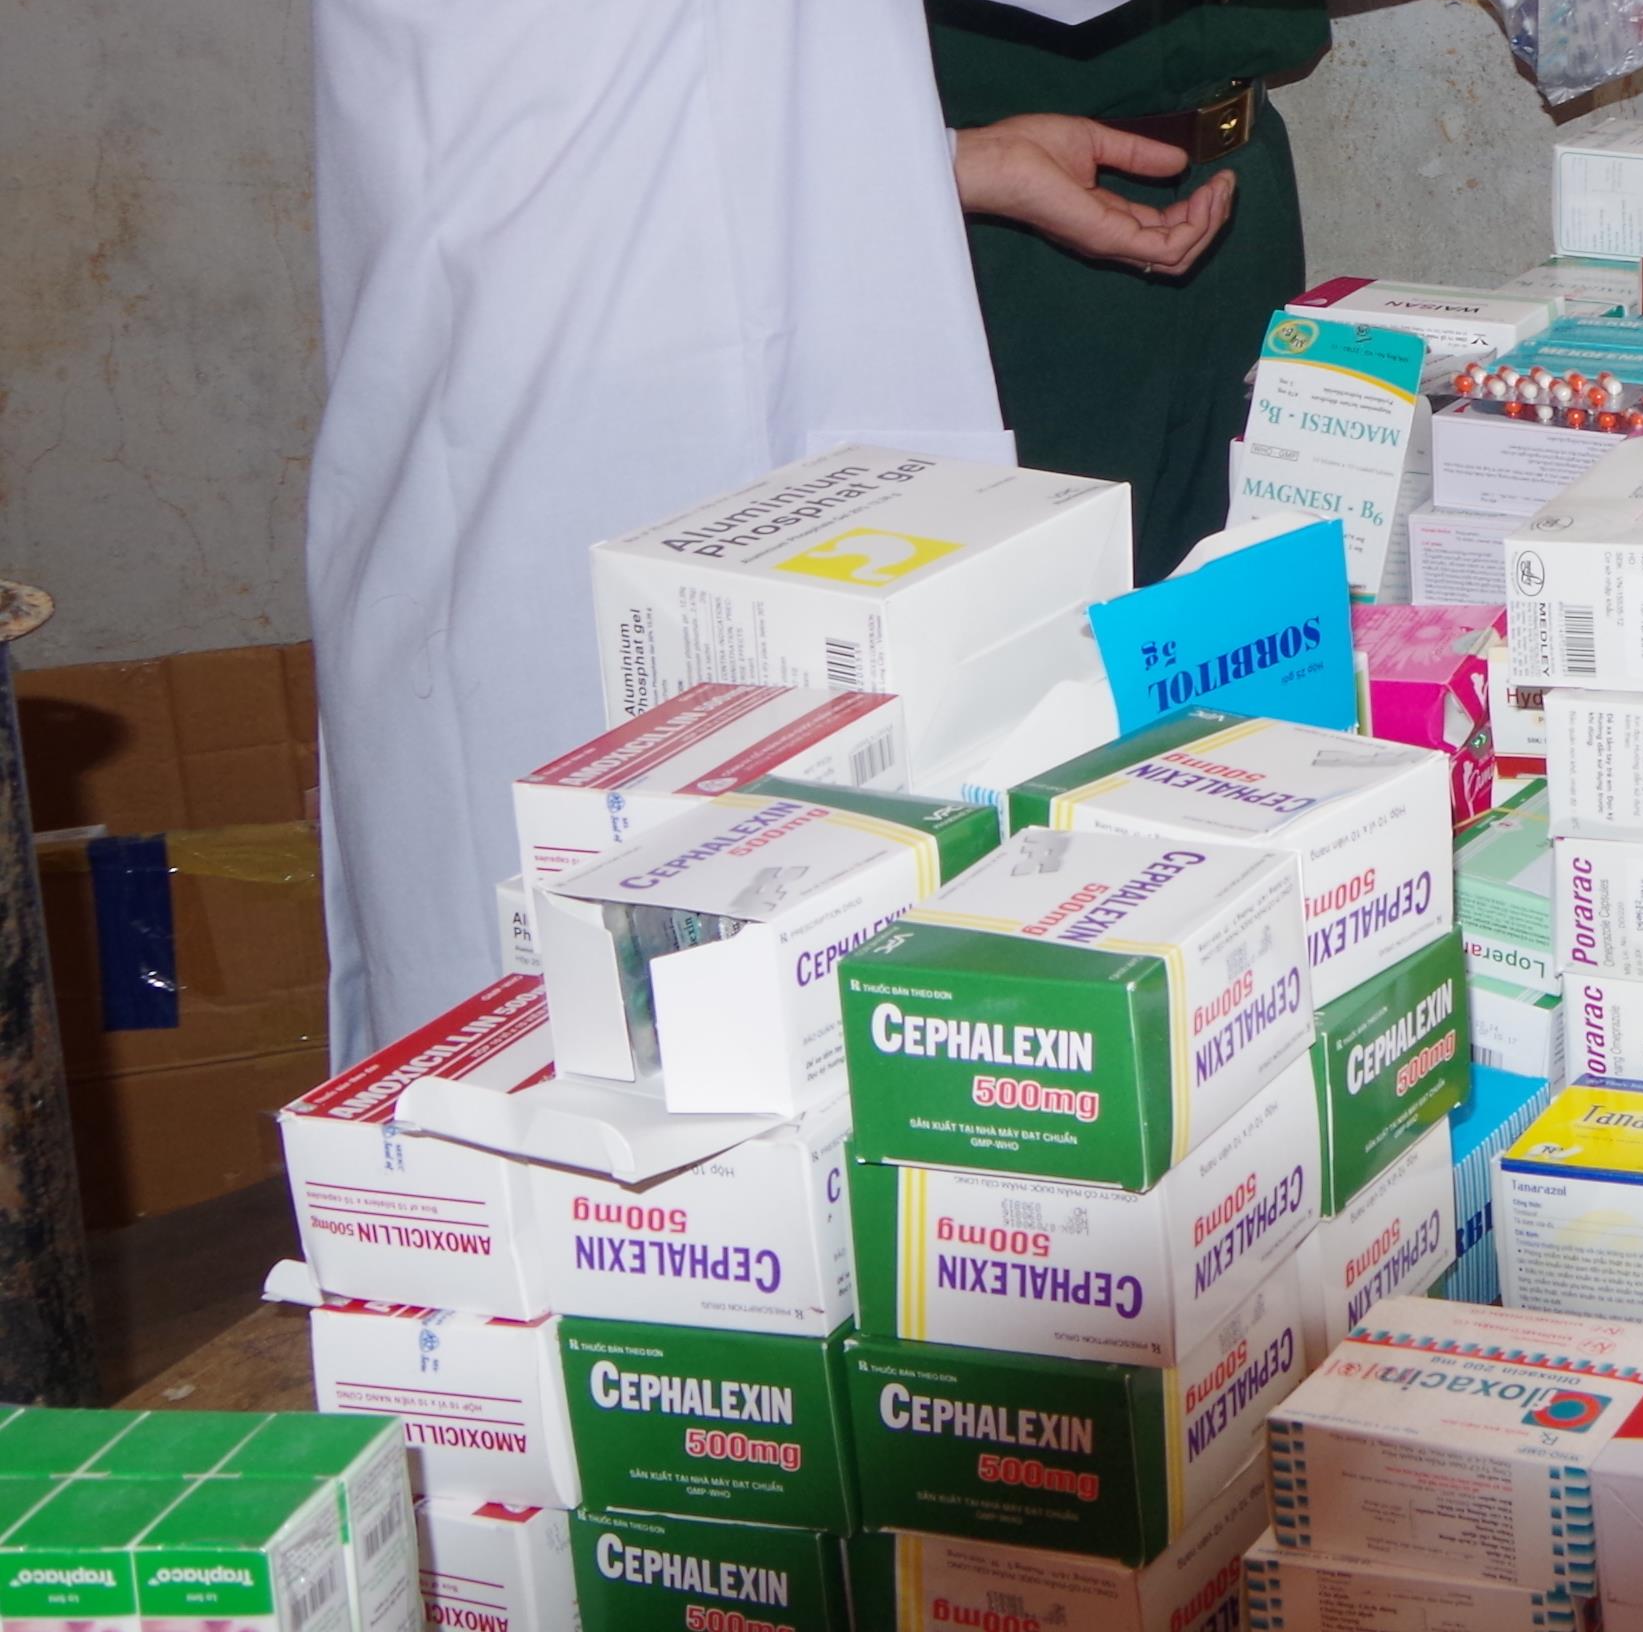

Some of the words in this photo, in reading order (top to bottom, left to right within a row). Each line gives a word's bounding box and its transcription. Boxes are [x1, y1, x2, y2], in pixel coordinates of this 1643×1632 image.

[1385, 300, 1480, 313] WAISAN
[1259, 399, 1281, 424] B6
[1302, 412, 1401, 446] MAGNESI
[661, 464, 870, 553] Aluminium
[695, 477, 880, 560] Phosphat
[878, 458, 936, 484] gel
[1242, 477, 1342, 513] MAGNESI
[1361, 500, 1383, 526] B6
[631, 608, 646, 634] gel
[1539, 602, 1550, 677] MEDLEY
[619, 623, 636, 717] Aluminium
[1148, 617, 1321, 714] SORBITOL
[558, 708, 702, 787] AMOXICILLIN
[1160, 752, 1266, 784] 500mg
[1126, 763, 1317, 815] CEPHALEXIN
[619, 801, 803, 890] CEPHALEXIN
[727, 808, 831, 858] 500mg
[1022, 882, 1109, 936] 500mg
[1057, 850, 1207, 943] CEPHALEXIN
[1572, 857, 1598, 967] Porarac
[863, 982, 891, 994] THUỐC
[911, 987, 933, 998] THEO
[1192, 970, 1254, 1036] 500mg
[871, 1003, 1093, 1072] CEPHALEXIN
[1195, 966, 1301, 1089] CEPHALEXIN
[1347, 978, 1452, 1095] CEPHALEXIN
[1584, 985, 1606, 1077] orarac
[328, 1013, 495, 1120] AMOXICILLIN
[1396, 1029, 1456, 1097] 500mg
[973, 1076, 1099, 1122] 500mg
[976, 1124, 997, 1136] NHÀ
[998, 1127, 1019, 1138] MÁY
[970, 1137, 1019, 1151] GMP-WHO
[573, 1196, 688, 1234] 500mg
[1193, 1173, 1257, 1249] 500mg
[1512, 1180, 1567, 1196] Tanarazol
[311, 1216, 354, 1236] 500mg
[357, 1223, 491, 1256] AMOXICILLIN
[937, 1216, 1050, 1257] 500mg
[1194, 1164, 1304, 1299] CEPHALEXIN
[1345, 1218, 1401, 1289] 500mg
[575, 1234, 782, 1295] CEPHALEXIN
[938, 1254, 1143, 1319] CEPHALEXIN
[1347, 1208, 1442, 1331] CEPHALEXIN
[590, 1360, 792, 1425] CEPHALEXIN
[1185, 1339, 1247, 1414] 500mg
[1187, 1327, 1294, 1464] CEPHALEXIN
[405, 1423, 527, 1453] AMOXICILLI
[685, 1428, 801, 1472] 500mg
[880, 1383, 1094, 1455] CEPHALEXIN
[686, 1486, 731, 1499] GMP-WHO
[978, 1454, 1099, 1501] 500mg
[10, 1567, 117, 1587] Traphaco
[149, 1566, 255, 1587] Traphaco
[596, 1533, 788, 1608] CEPHALEXIN
